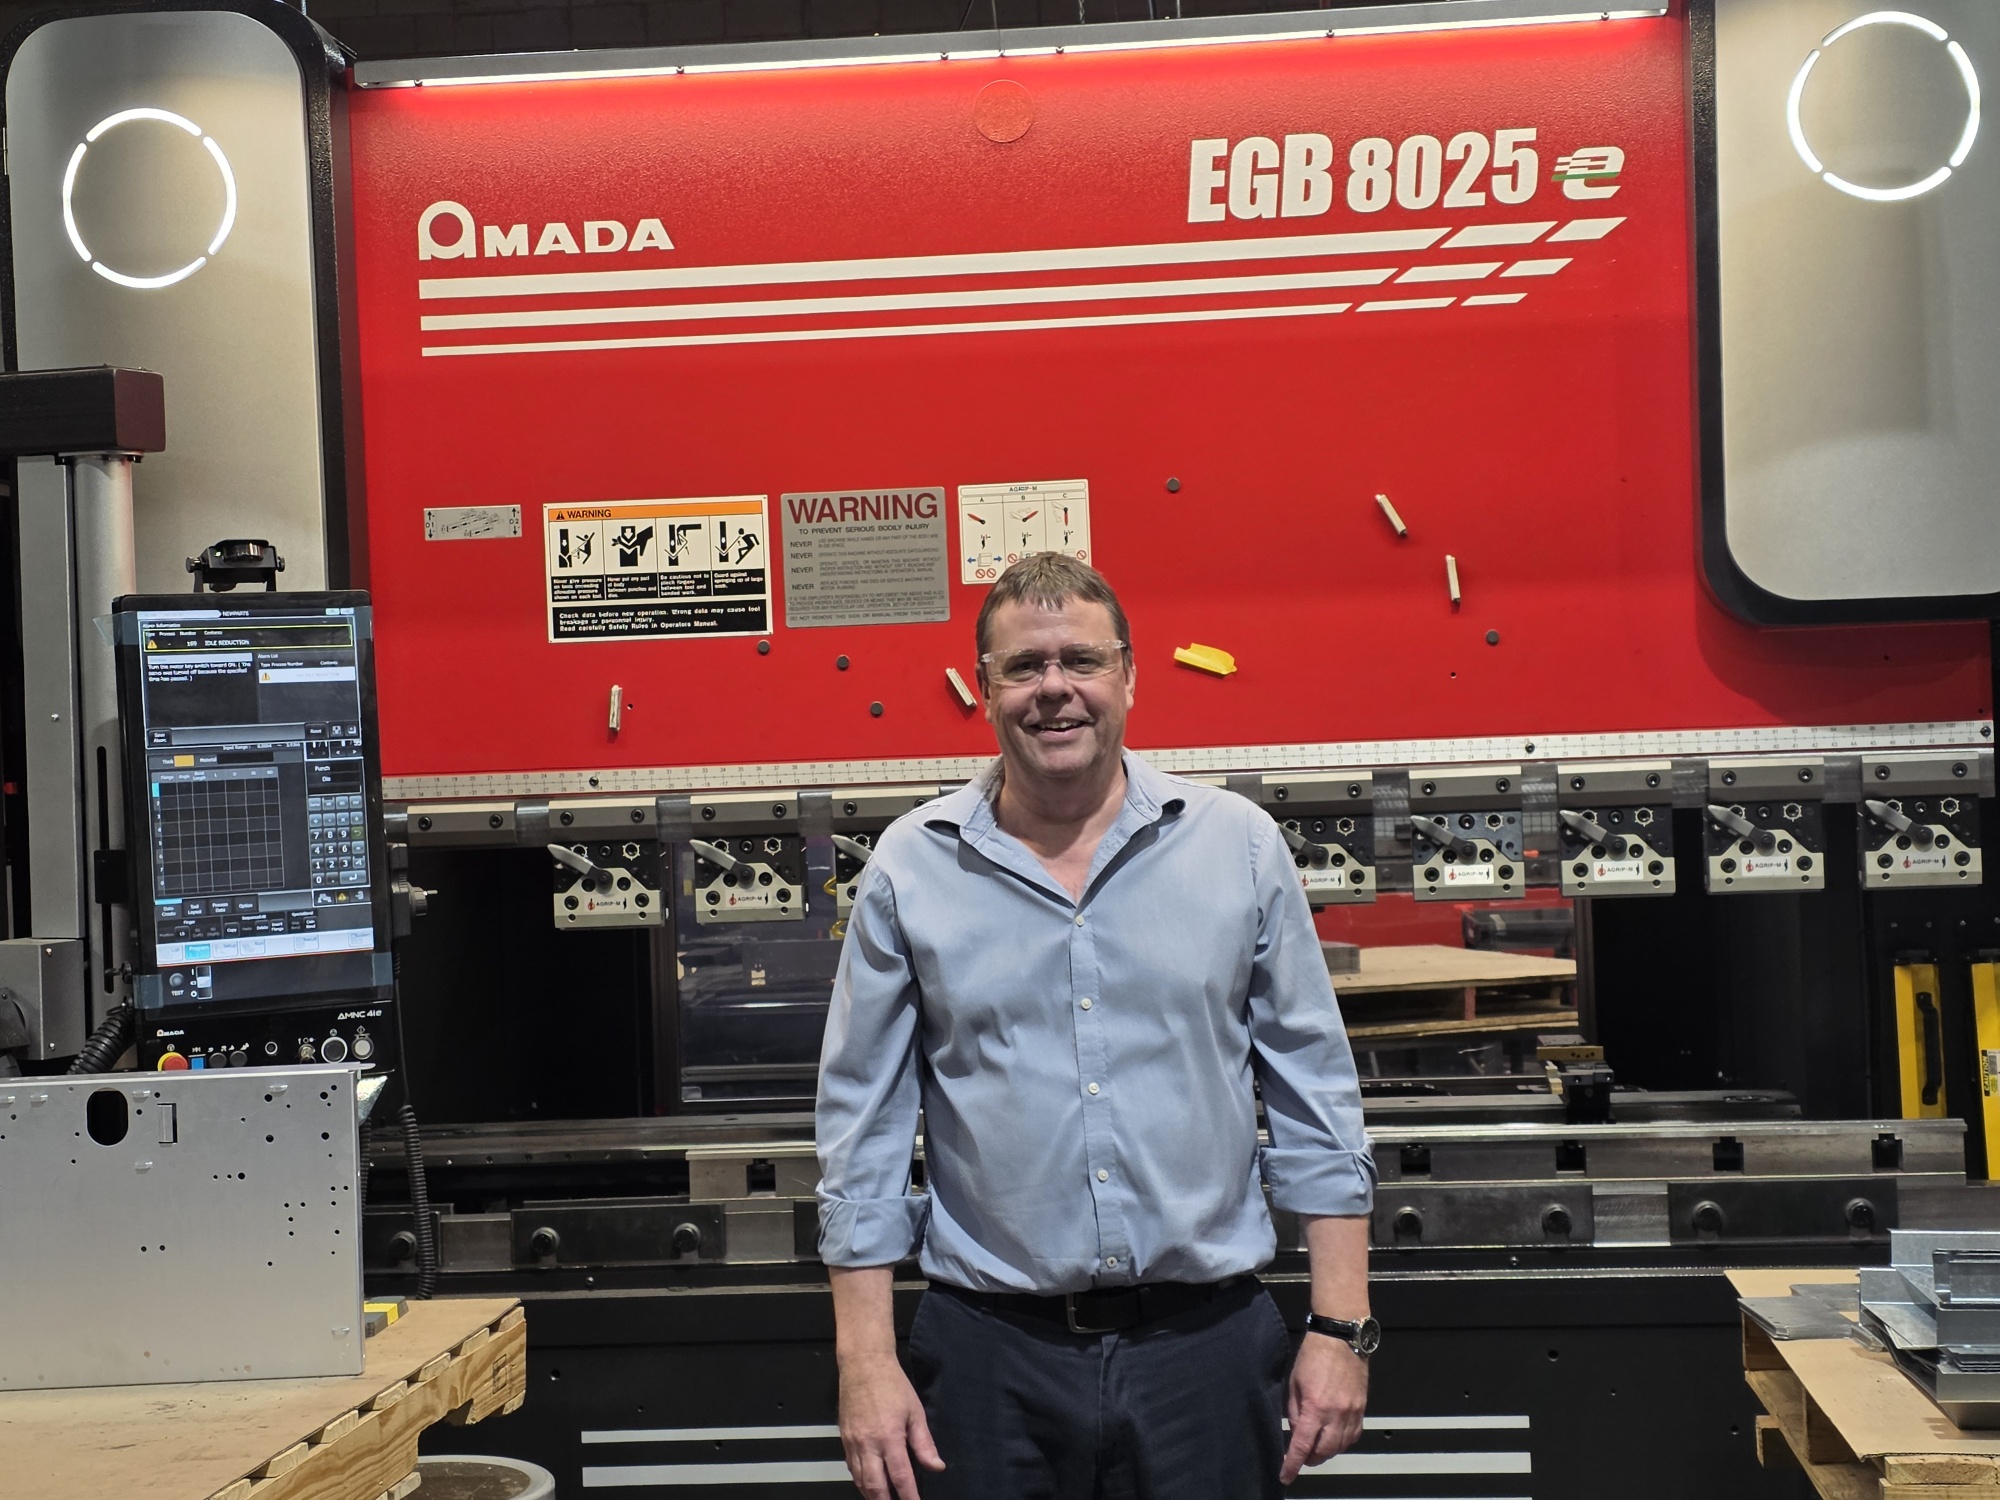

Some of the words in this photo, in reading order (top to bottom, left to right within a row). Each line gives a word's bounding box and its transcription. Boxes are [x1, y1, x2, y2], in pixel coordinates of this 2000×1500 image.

[1187, 132, 1333, 223] EGB
[1347, 127, 1539, 213] 8025
[418, 200, 675, 260] AMADA
[787, 492, 938, 524] WARNING
[567, 509, 612, 519] WARNING
[313, 832, 320, 840] 7
[327, 830, 333, 839] 8
[341, 830, 347, 838] 9
[314, 846, 321, 855] 4
[328, 845, 334, 854] 5
[342, 845, 348, 853] 6
[315, 861, 321, 869] 1
[329, 860, 335, 868] 2
[342, 859, 348, 867] 3
[1606, 865, 1633, 873] AGRIP-M
[1457, 870, 1484, 878] AGRIP-M
[315, 876, 322, 884] 0
[1309, 876, 1336, 885] AGRIP-M
[737, 895, 762, 903] AGRIP-M
[337, 1011, 366, 1020] AMNC
[157, 1029, 184, 1037] AMADA
